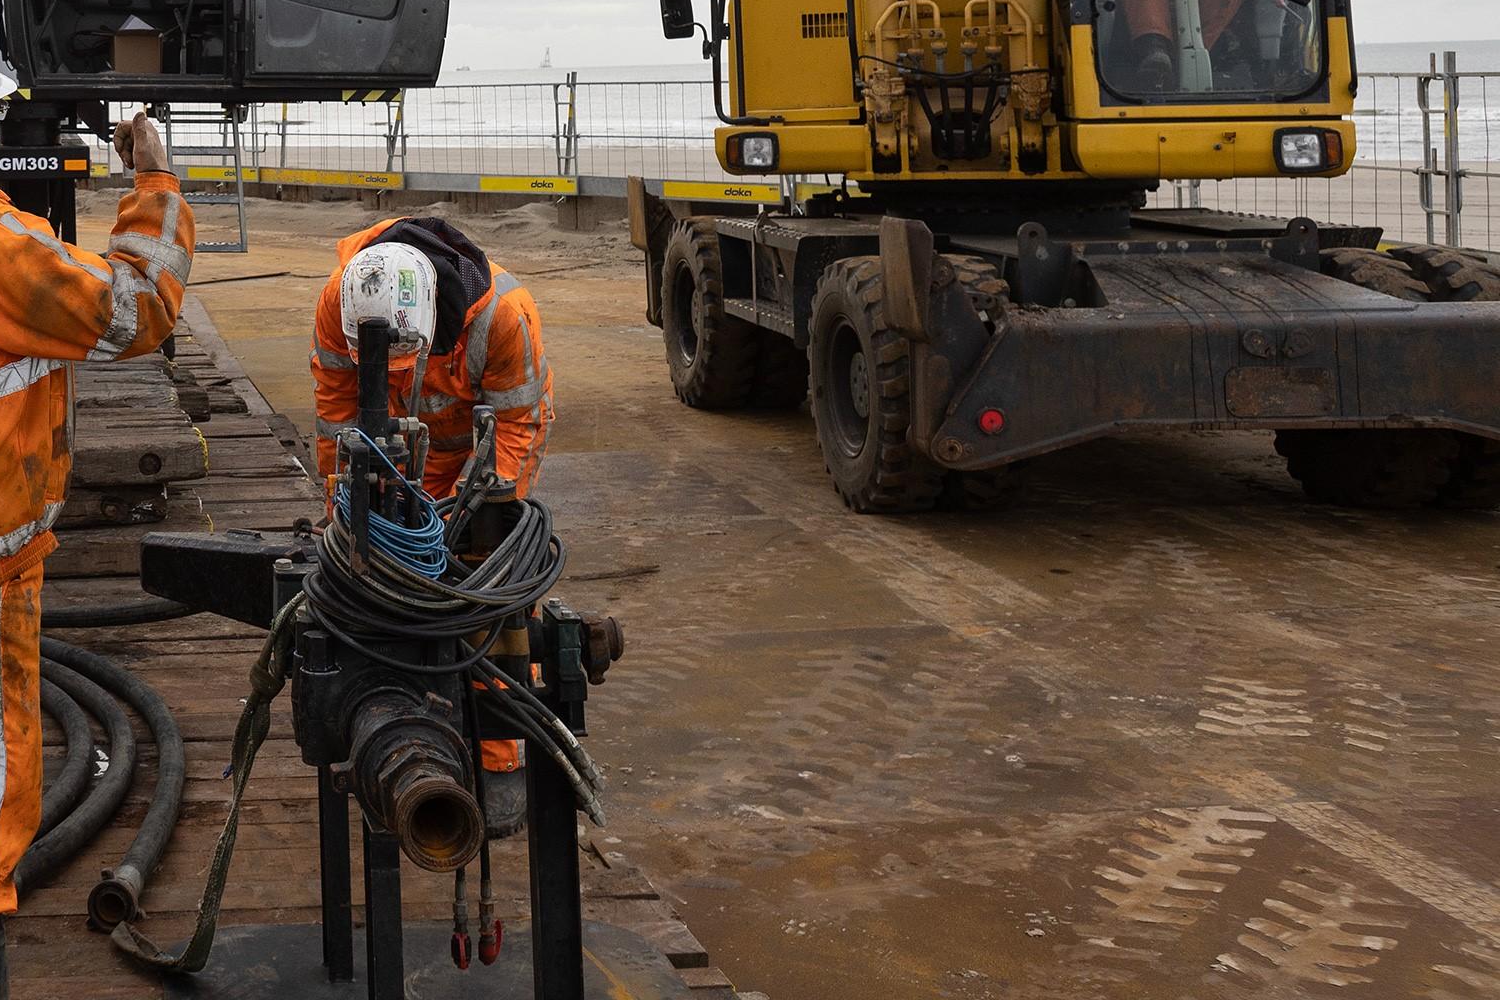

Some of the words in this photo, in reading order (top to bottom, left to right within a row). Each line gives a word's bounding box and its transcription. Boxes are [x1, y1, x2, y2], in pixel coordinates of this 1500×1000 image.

[365, 175, 388, 184] doka
[530, 180, 554, 189] doka
[724, 187, 752, 197] doka
